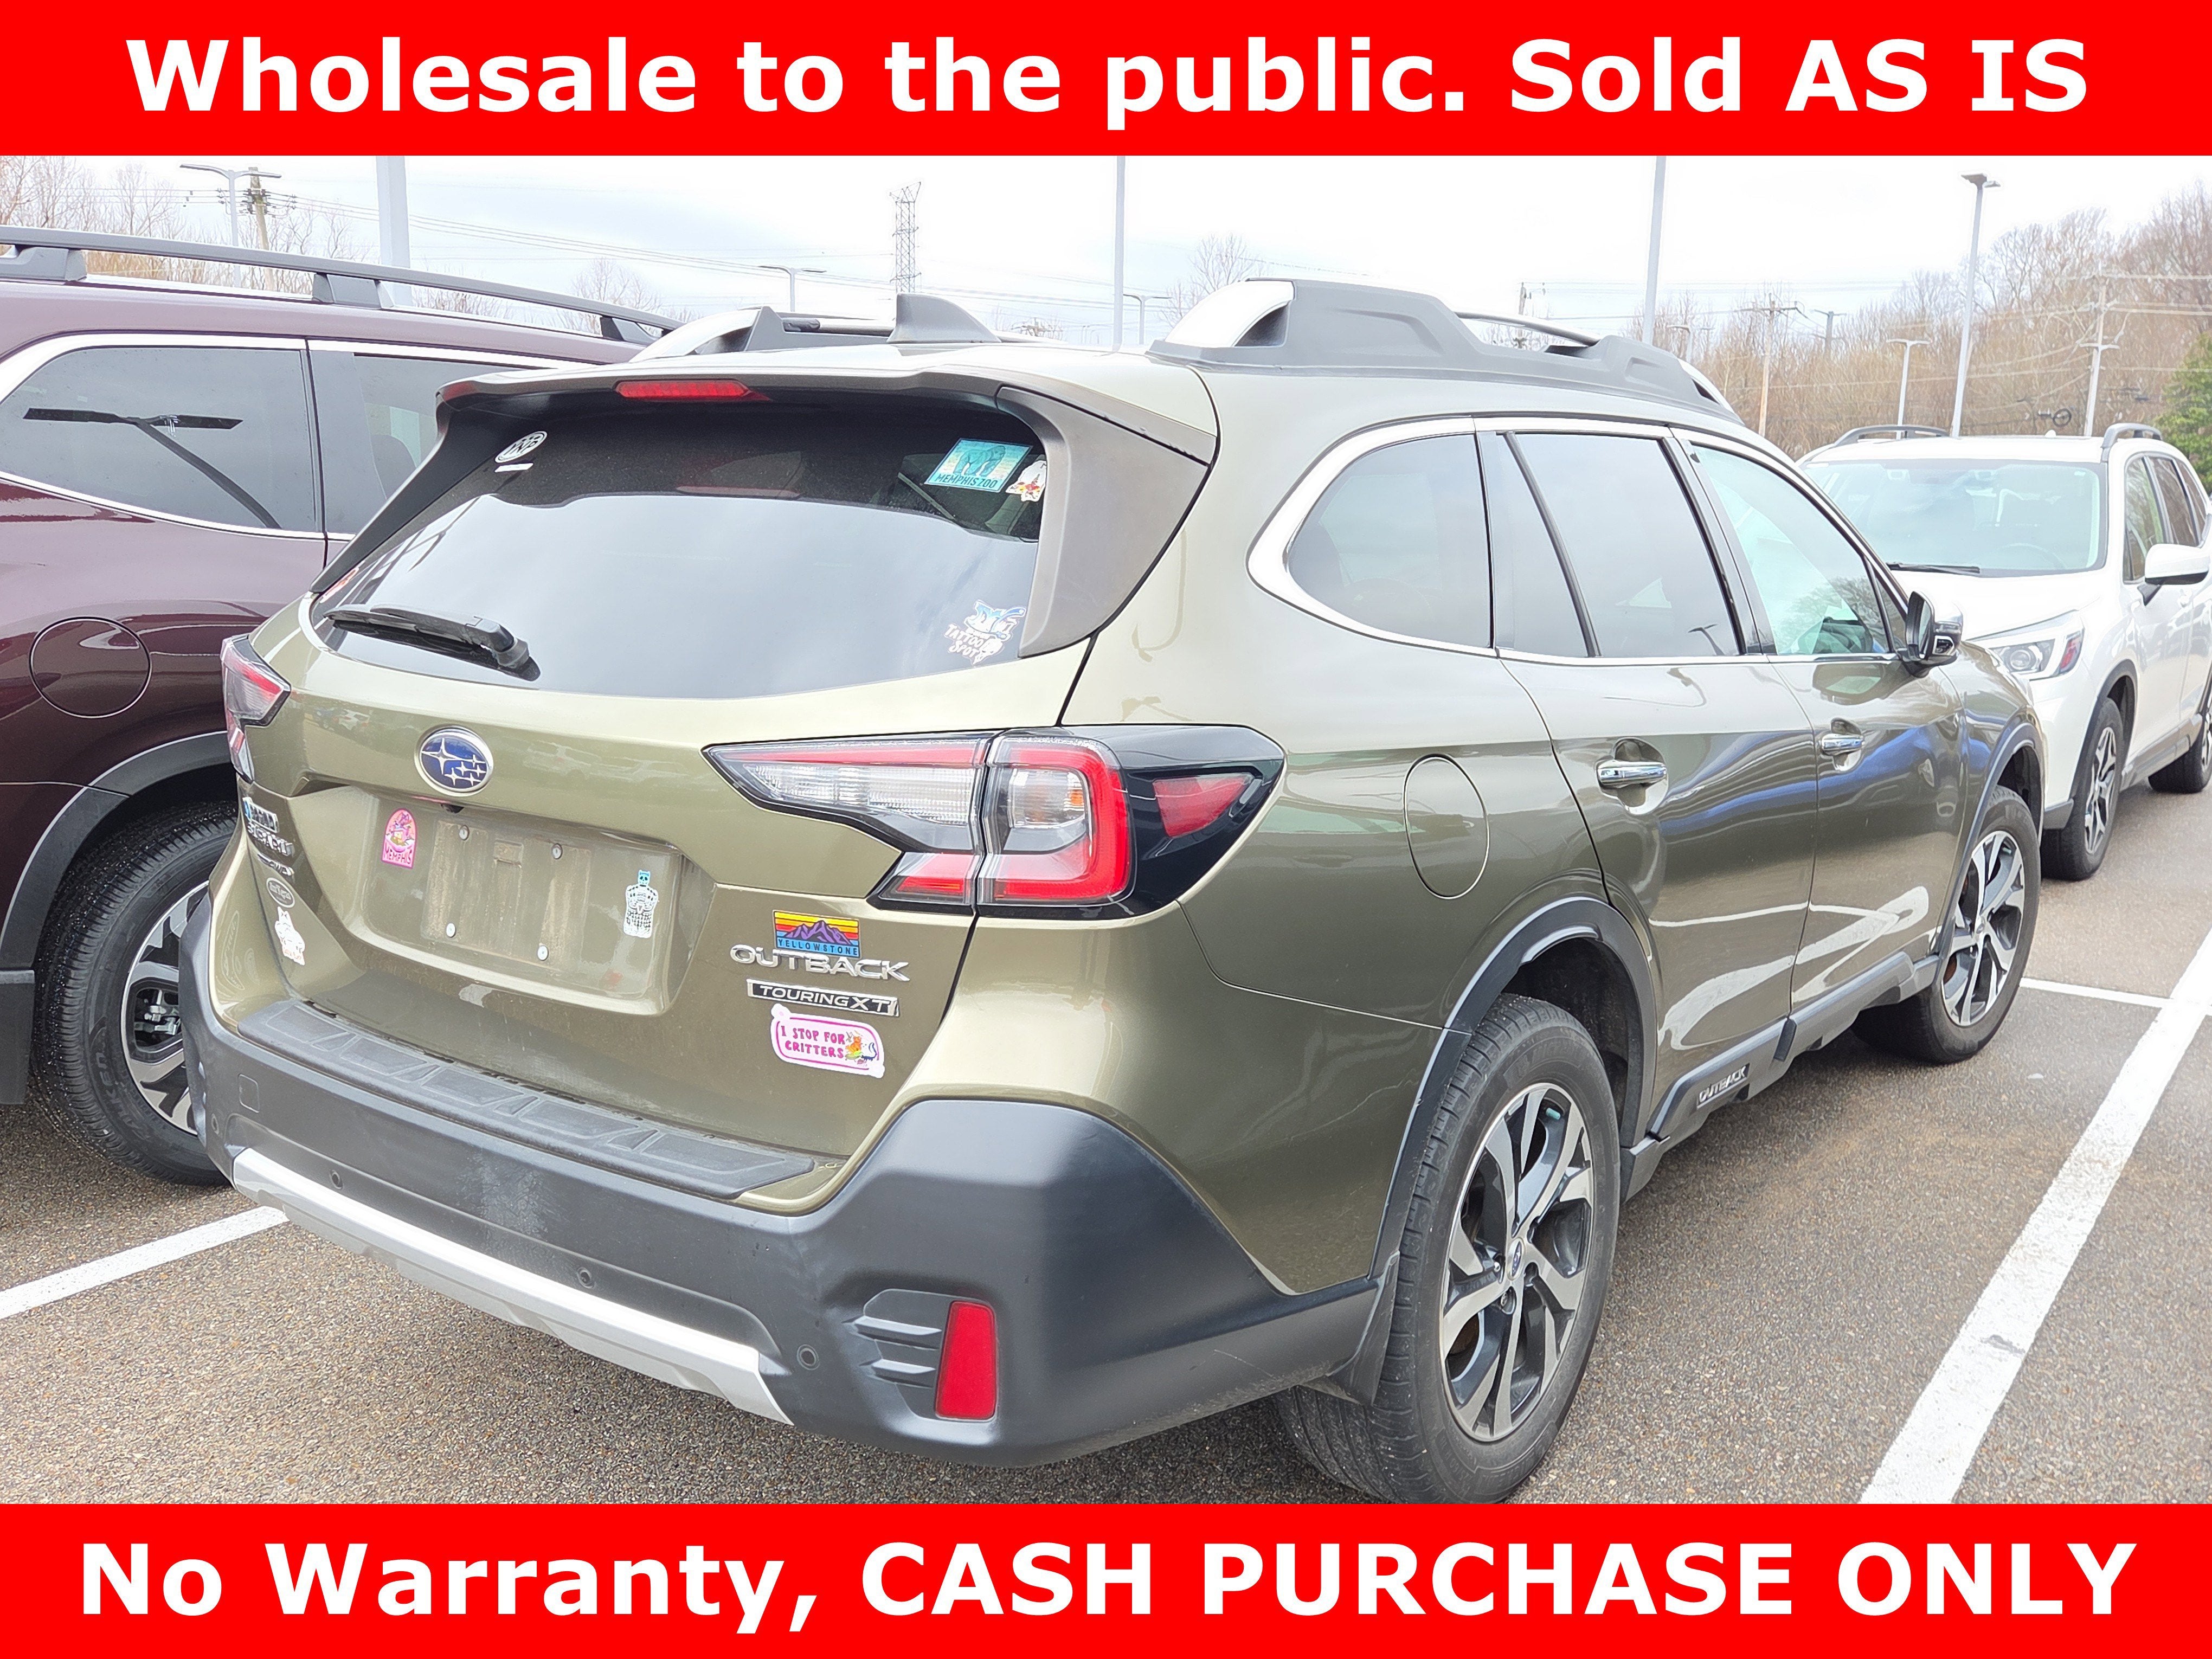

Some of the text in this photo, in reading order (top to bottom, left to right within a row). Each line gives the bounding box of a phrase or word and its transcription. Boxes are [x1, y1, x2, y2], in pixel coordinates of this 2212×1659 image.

[935, 473, 999, 488] MEMPHIS ZOO
[948, 640, 981, 658] SPOT
[383, 842, 413, 865] MEMPHIS
[777, 938, 858, 955] YELLOWSTONE
[730, 944, 911, 981] OUTBACK
[781, 1025, 846, 1045] I STOP FOR
[785, 1040, 845, 1059] CRITTERS
